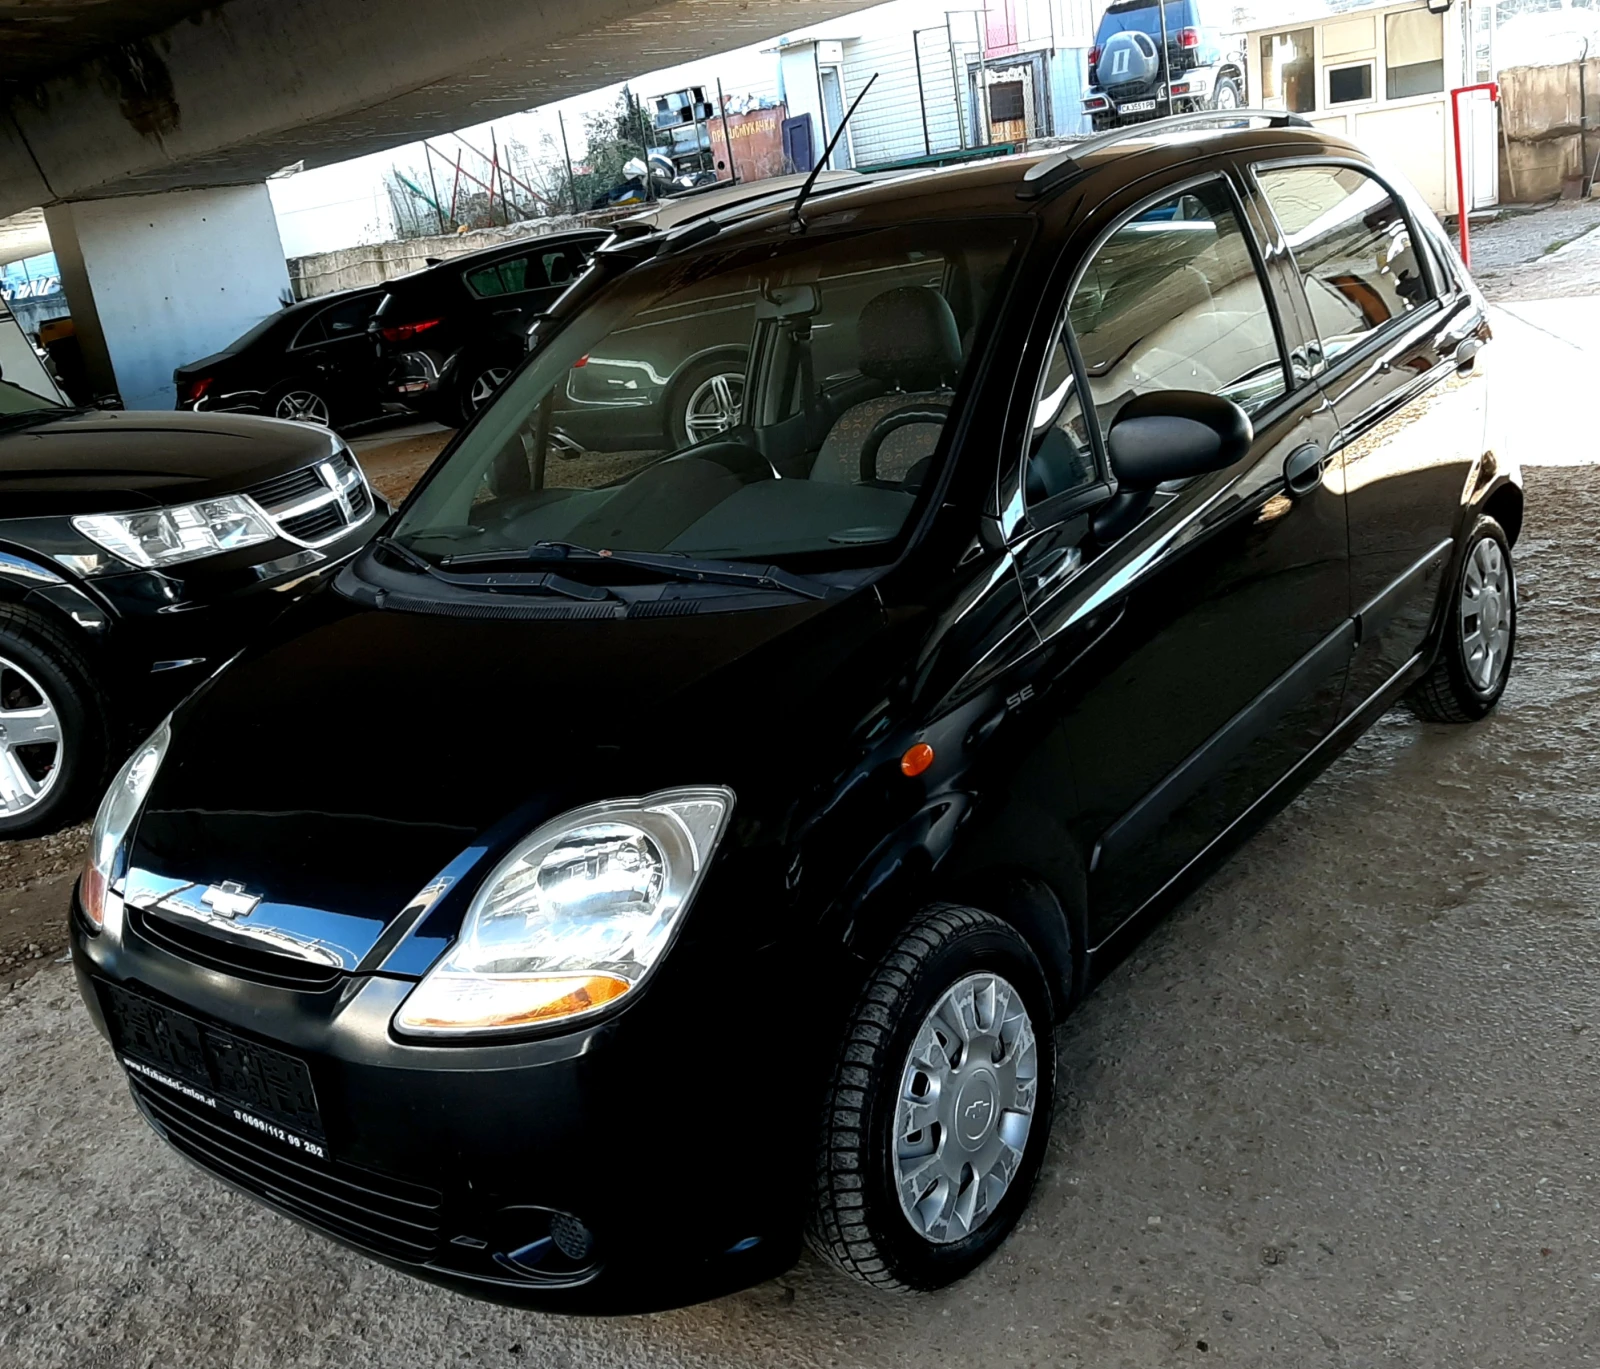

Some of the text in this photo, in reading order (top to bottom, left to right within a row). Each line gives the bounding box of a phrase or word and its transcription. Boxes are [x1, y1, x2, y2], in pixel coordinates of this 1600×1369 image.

[711, 118, 776, 143] ПРАОСМУКАЧКА
[1006, 683, 1035, 710] SE
[123, 1057, 217, 1108] www.kfzhandel-anton.at
[242, 1112, 324, 1158] 0699/112 99 282
